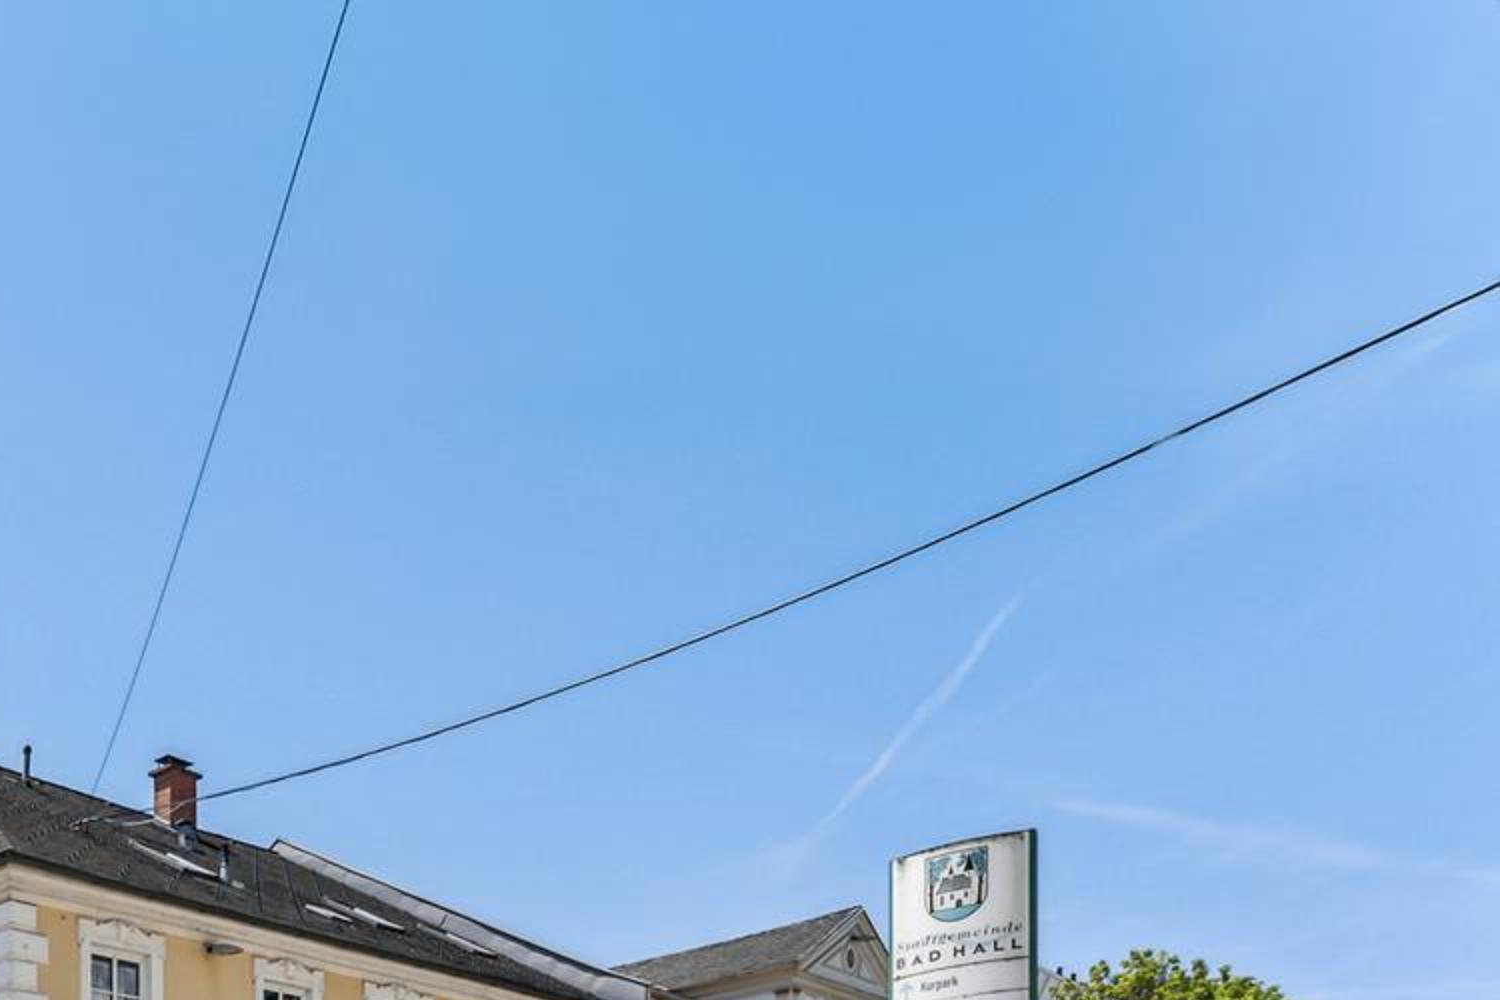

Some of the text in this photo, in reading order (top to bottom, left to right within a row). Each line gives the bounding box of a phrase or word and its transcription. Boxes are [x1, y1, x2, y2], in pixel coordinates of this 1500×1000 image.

[896, 938, 1023, 970] BAD HALL
[920, 976, 958, 992] Kurpark
